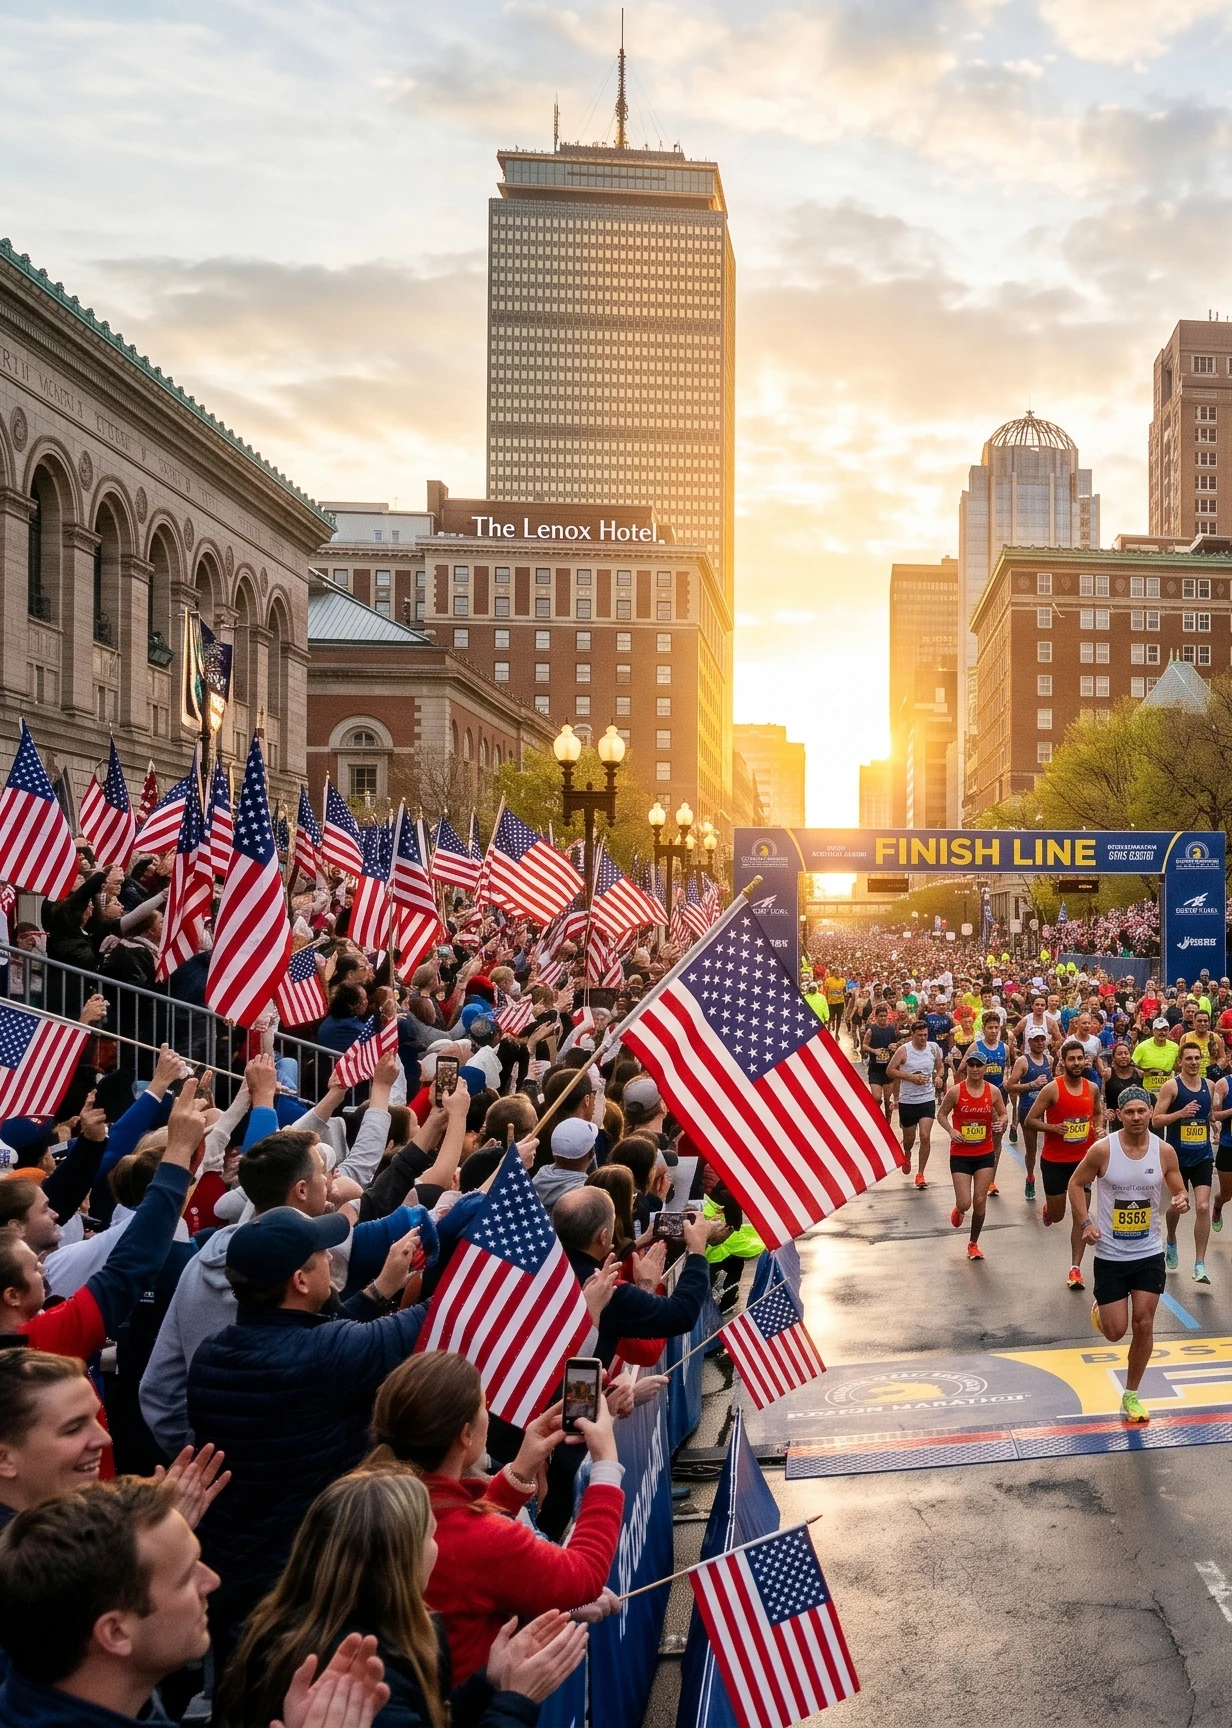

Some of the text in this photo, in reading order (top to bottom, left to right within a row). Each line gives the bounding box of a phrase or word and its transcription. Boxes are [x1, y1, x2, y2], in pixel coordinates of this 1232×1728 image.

[471, 516, 657, 542] The Lenox Hotel
[875, 837, 1000, 866] FINISH
[1013, 838, 1097, 866] LINE
